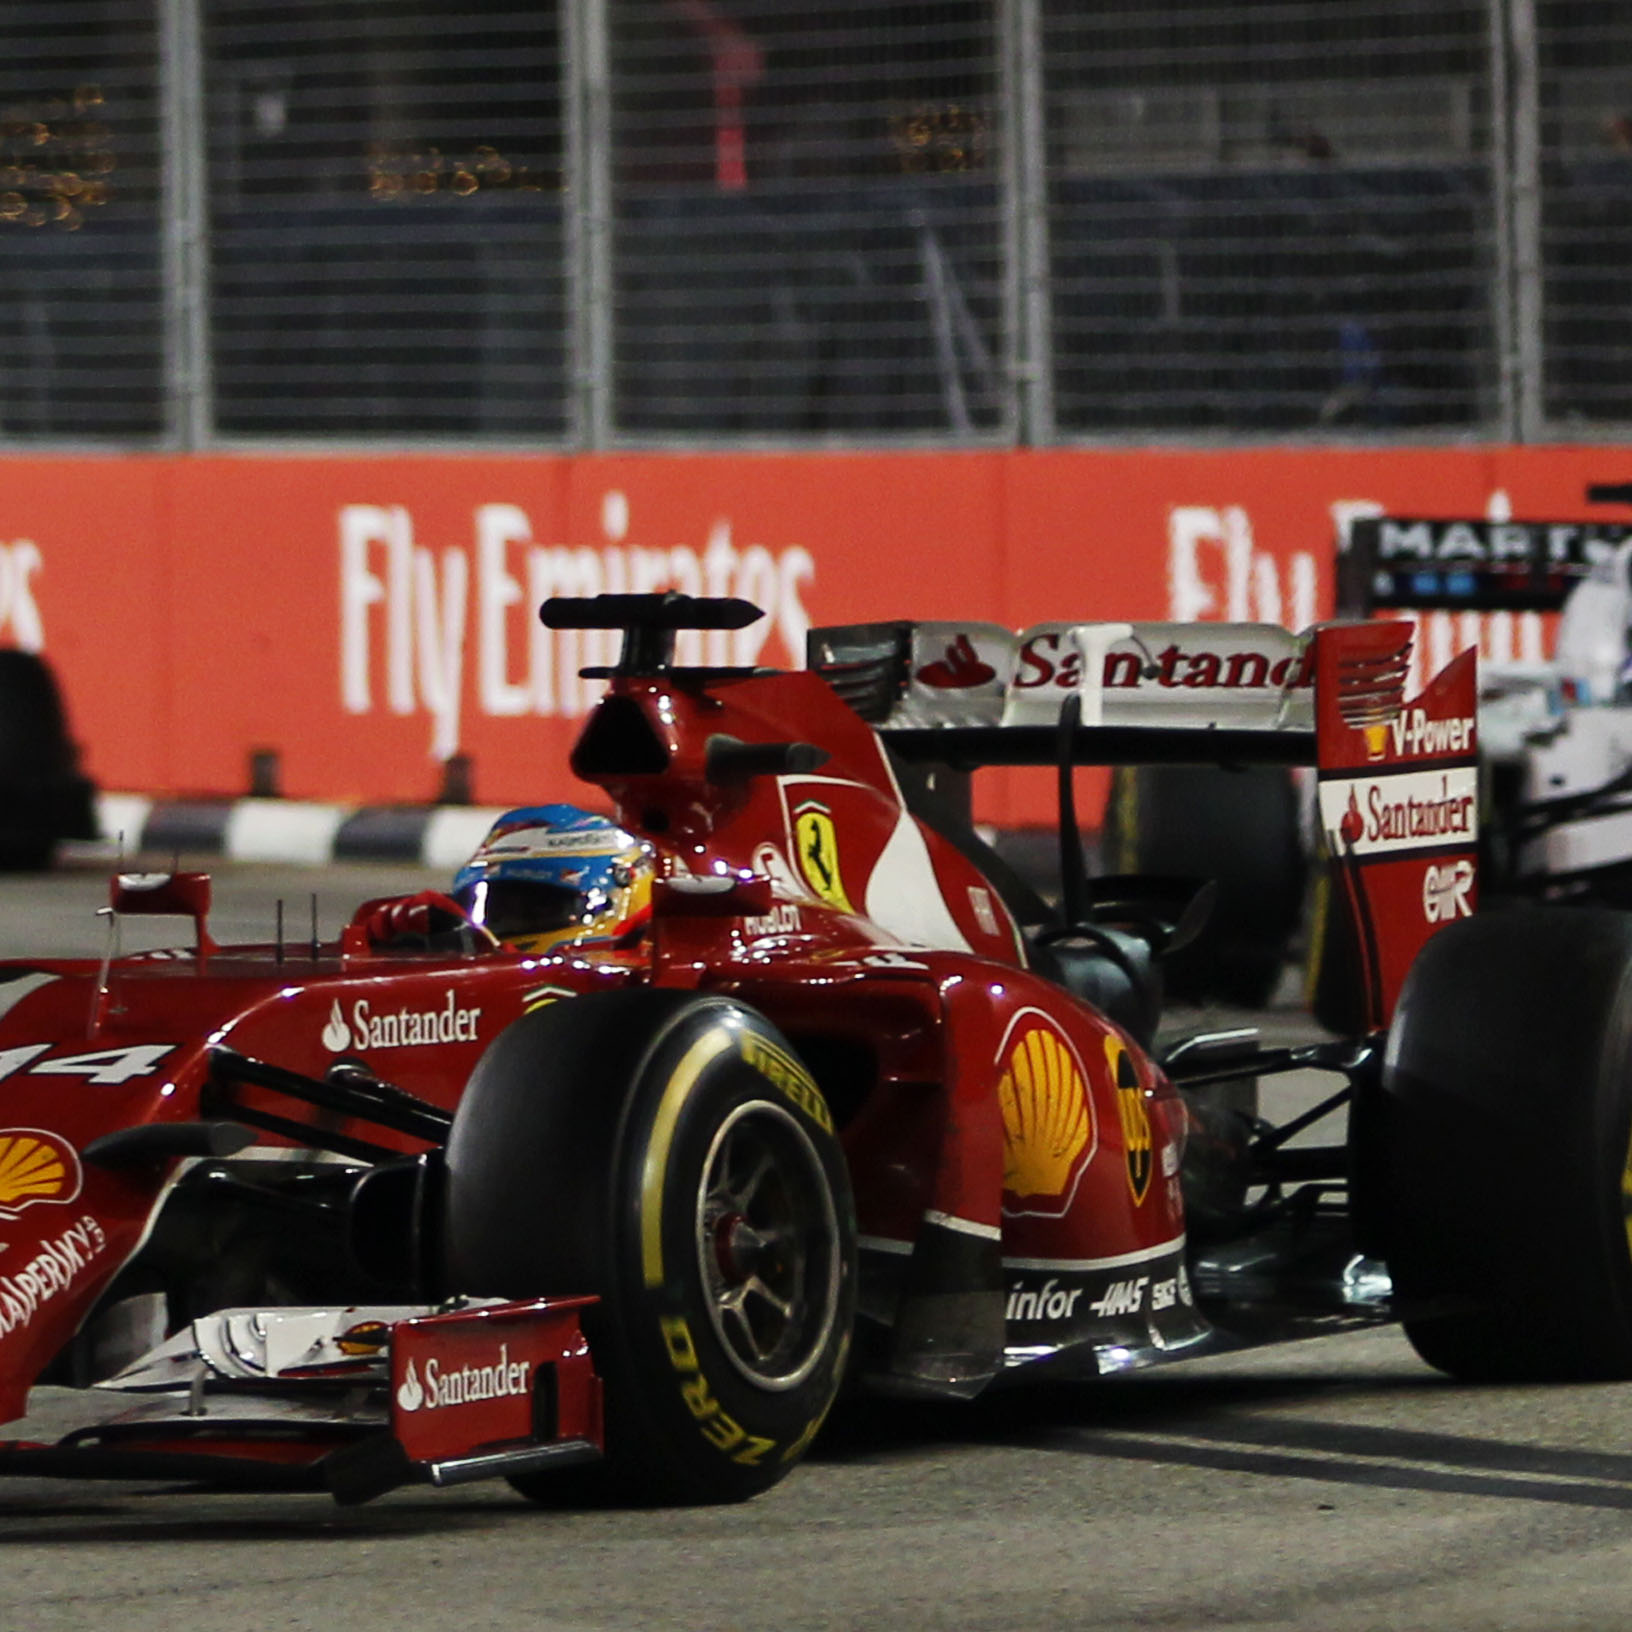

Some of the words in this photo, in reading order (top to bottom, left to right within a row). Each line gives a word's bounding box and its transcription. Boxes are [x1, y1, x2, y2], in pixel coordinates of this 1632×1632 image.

[338, 502, 469, 762] Fly
[1013, 632, 1317, 690] Santand
[1391, 708, 1475, 758] V-Power
[1368, 775, 1475, 843] Santander
[352, 989, 482, 1051] Santander
[1005, 1279, 1083, 1320] infor
[424, 1344, 530, 1411] Santander
